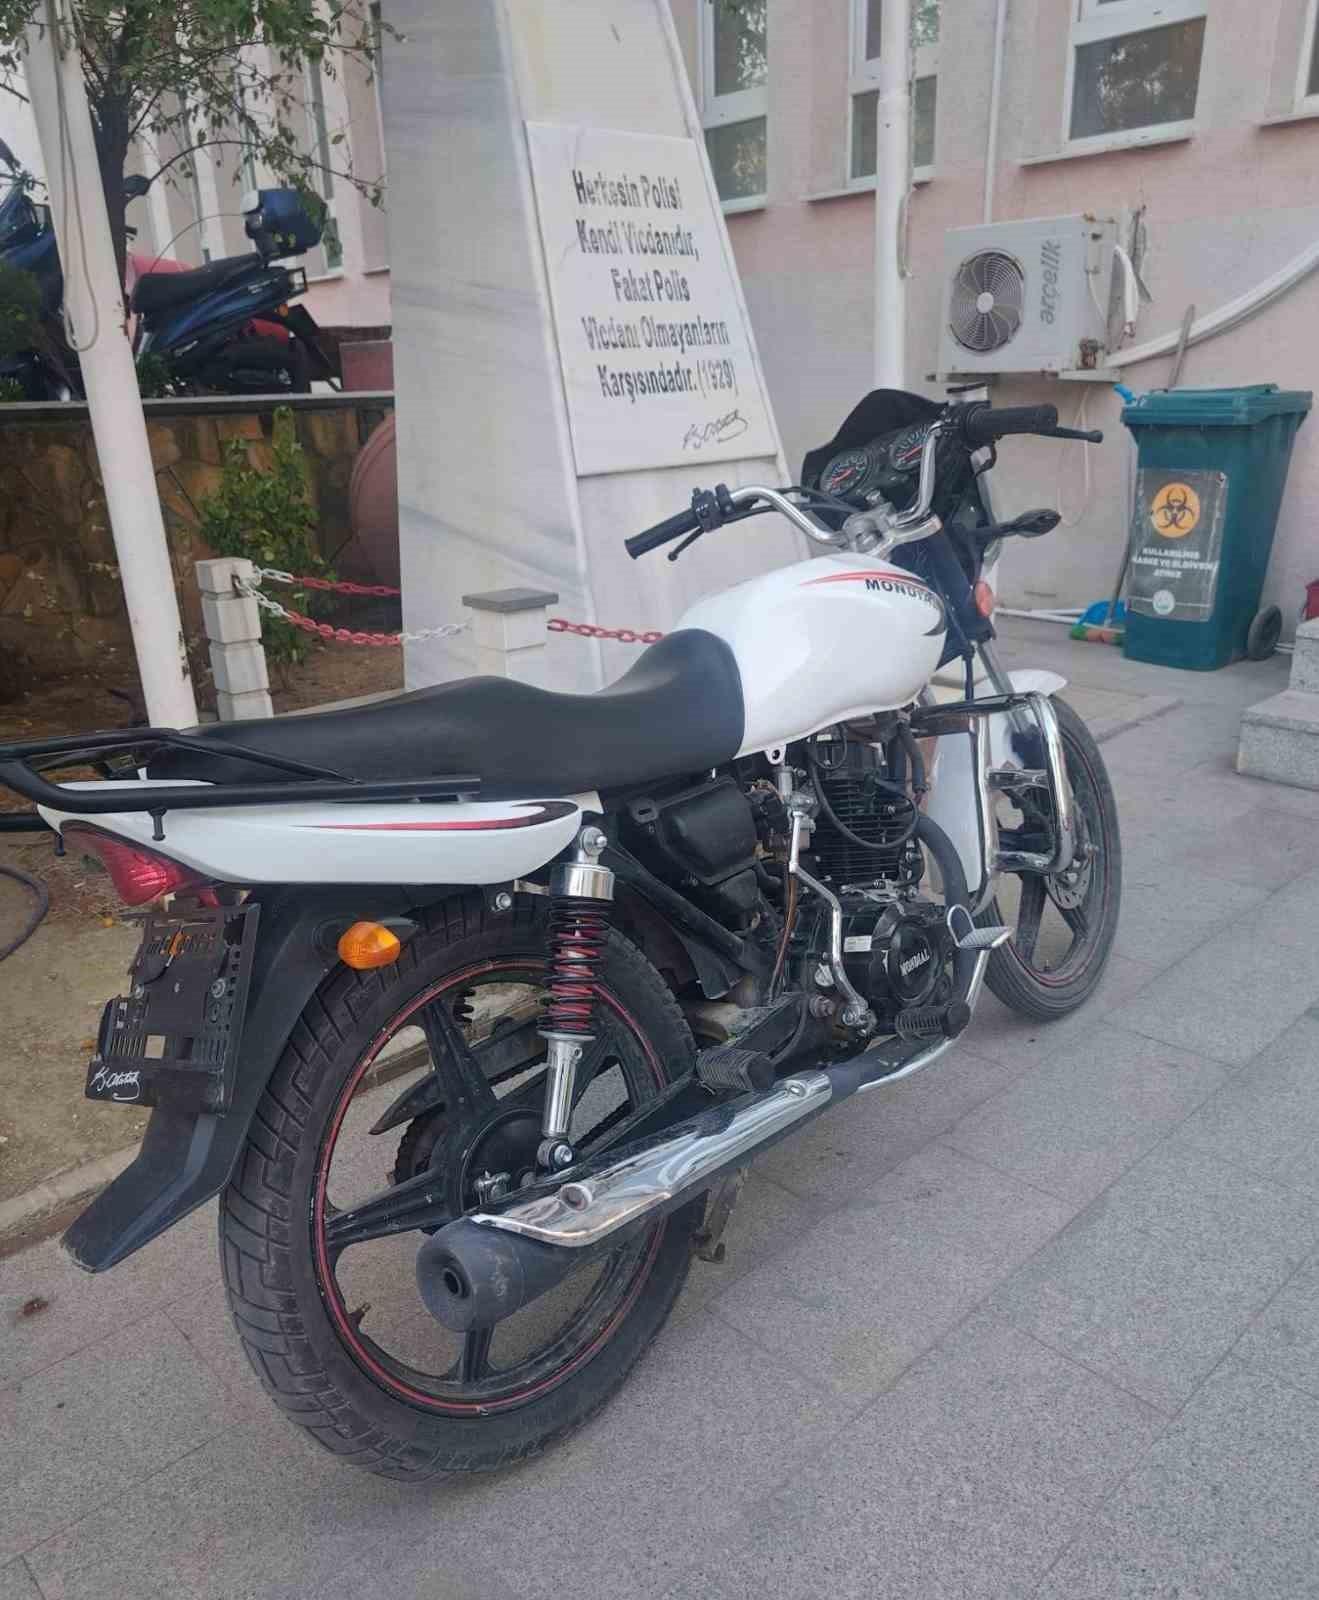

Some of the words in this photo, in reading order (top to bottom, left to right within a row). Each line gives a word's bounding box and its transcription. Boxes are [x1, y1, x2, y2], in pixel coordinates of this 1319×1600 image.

[572, 169, 642, 208] Herkesin
[575, 219, 624, 254] Kendi
[610, 268, 655, 302] Fakat
[652, 268, 691, 302] Polis
[1040, 240, 1061, 325] arçelik
[581, 315, 642, 351] Vicdanı
[640, 313, 731, 354] Olmayanların
[597, 361, 698, 404] Karşısındadır.
[696, 358, 739, 399] (1929)
